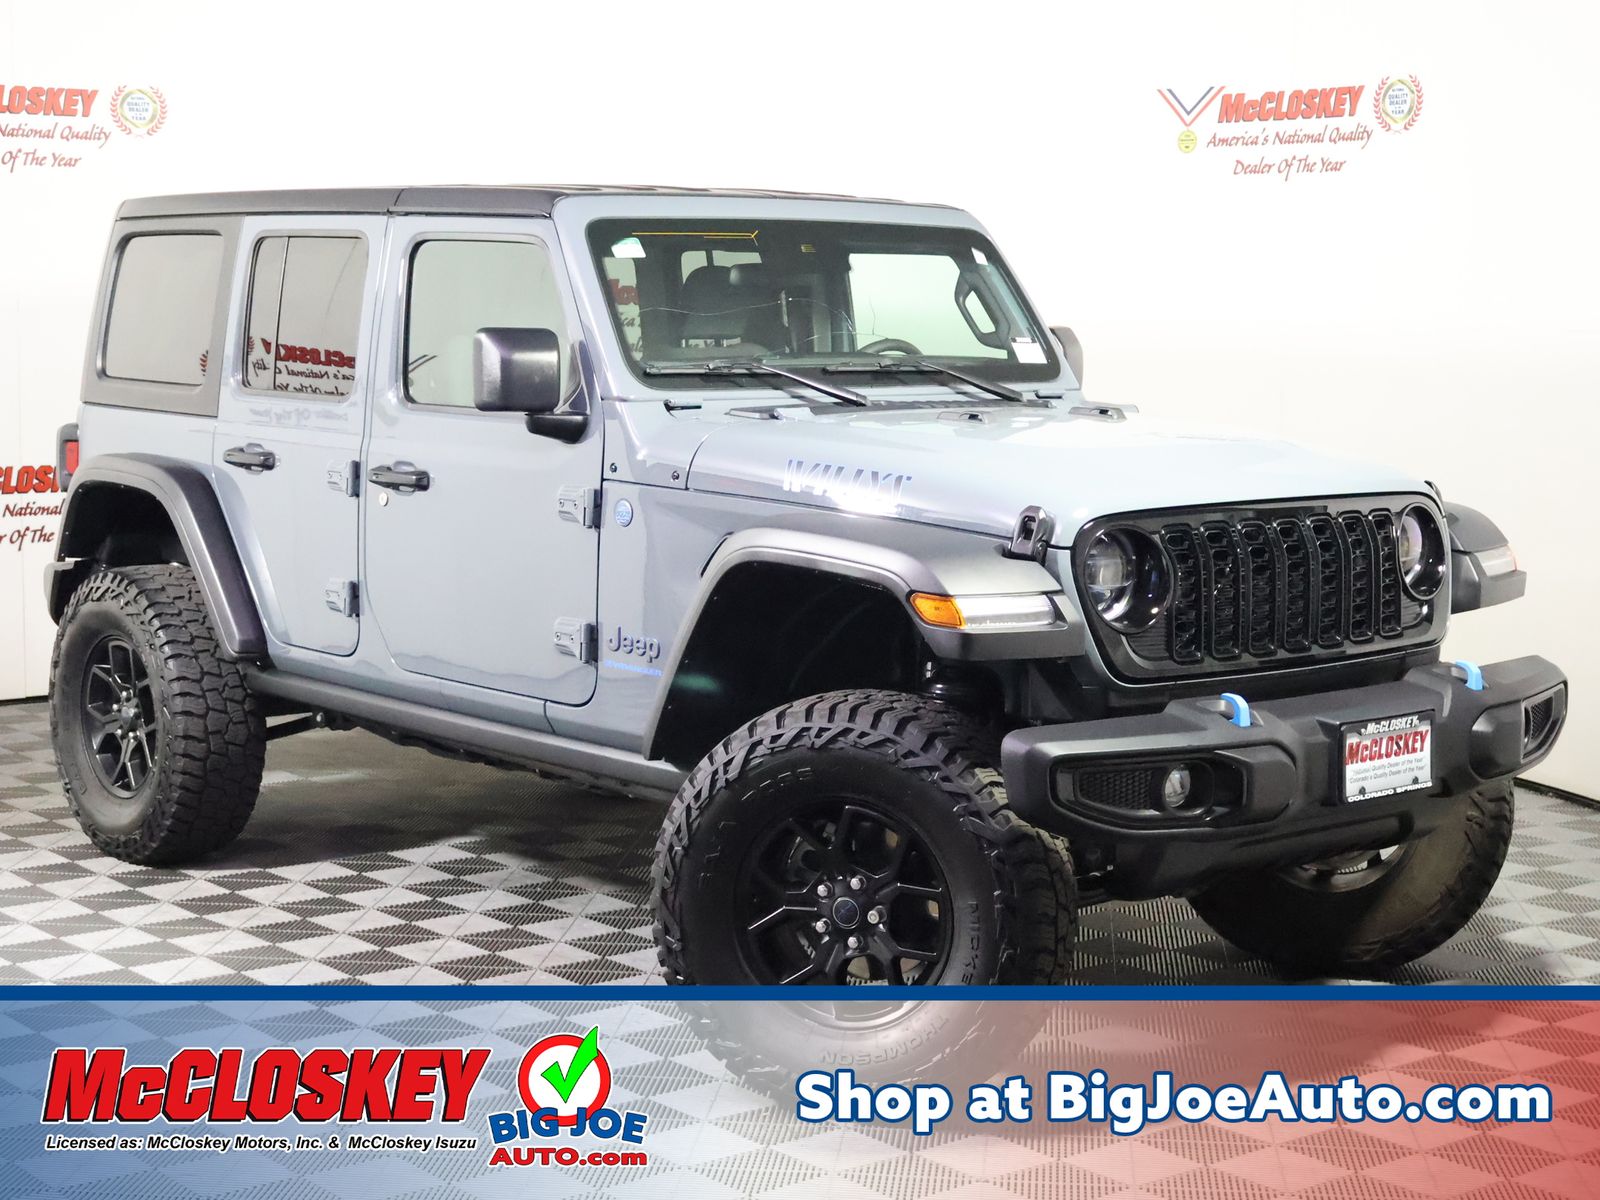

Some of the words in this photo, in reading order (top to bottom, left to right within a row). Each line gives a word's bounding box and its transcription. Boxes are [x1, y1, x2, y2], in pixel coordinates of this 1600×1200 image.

[1218, 85, 1365, 123] McCLOSKEY
[0, 122, 58, 140] National
[60, 124, 112, 149] Quality
[1207, 127, 1269, 148] America's
[1272, 125, 1327, 145] National
[1328, 123, 1374, 149] Quality
[1, 148, 22, 173] Of
[23, 149, 47, 166] The
[51, 152, 82, 168] Year
[1233, 157, 1275, 175] Dealer
[1277, 155, 1297, 182] Of
[1297, 155, 1317, 173] The
[1320, 157, 1347, 173] Year
[3, 498, 66, 517] National
[9, 526, 30, 551] Of
[31, 525, 55, 543] The
[608, 626, 661, 663] Jeep
[1366, 715, 1419, 734] McCLOSKEY
[1345, 730, 1429, 765] McCLOSKEY
[1347, 789, 1395, 803] COLORADO
[1396, 781, 1432, 793] SPRINGS
[962, 901, 981, 986] MICKE
[821, 1016, 949, 1066] THOMPSON
